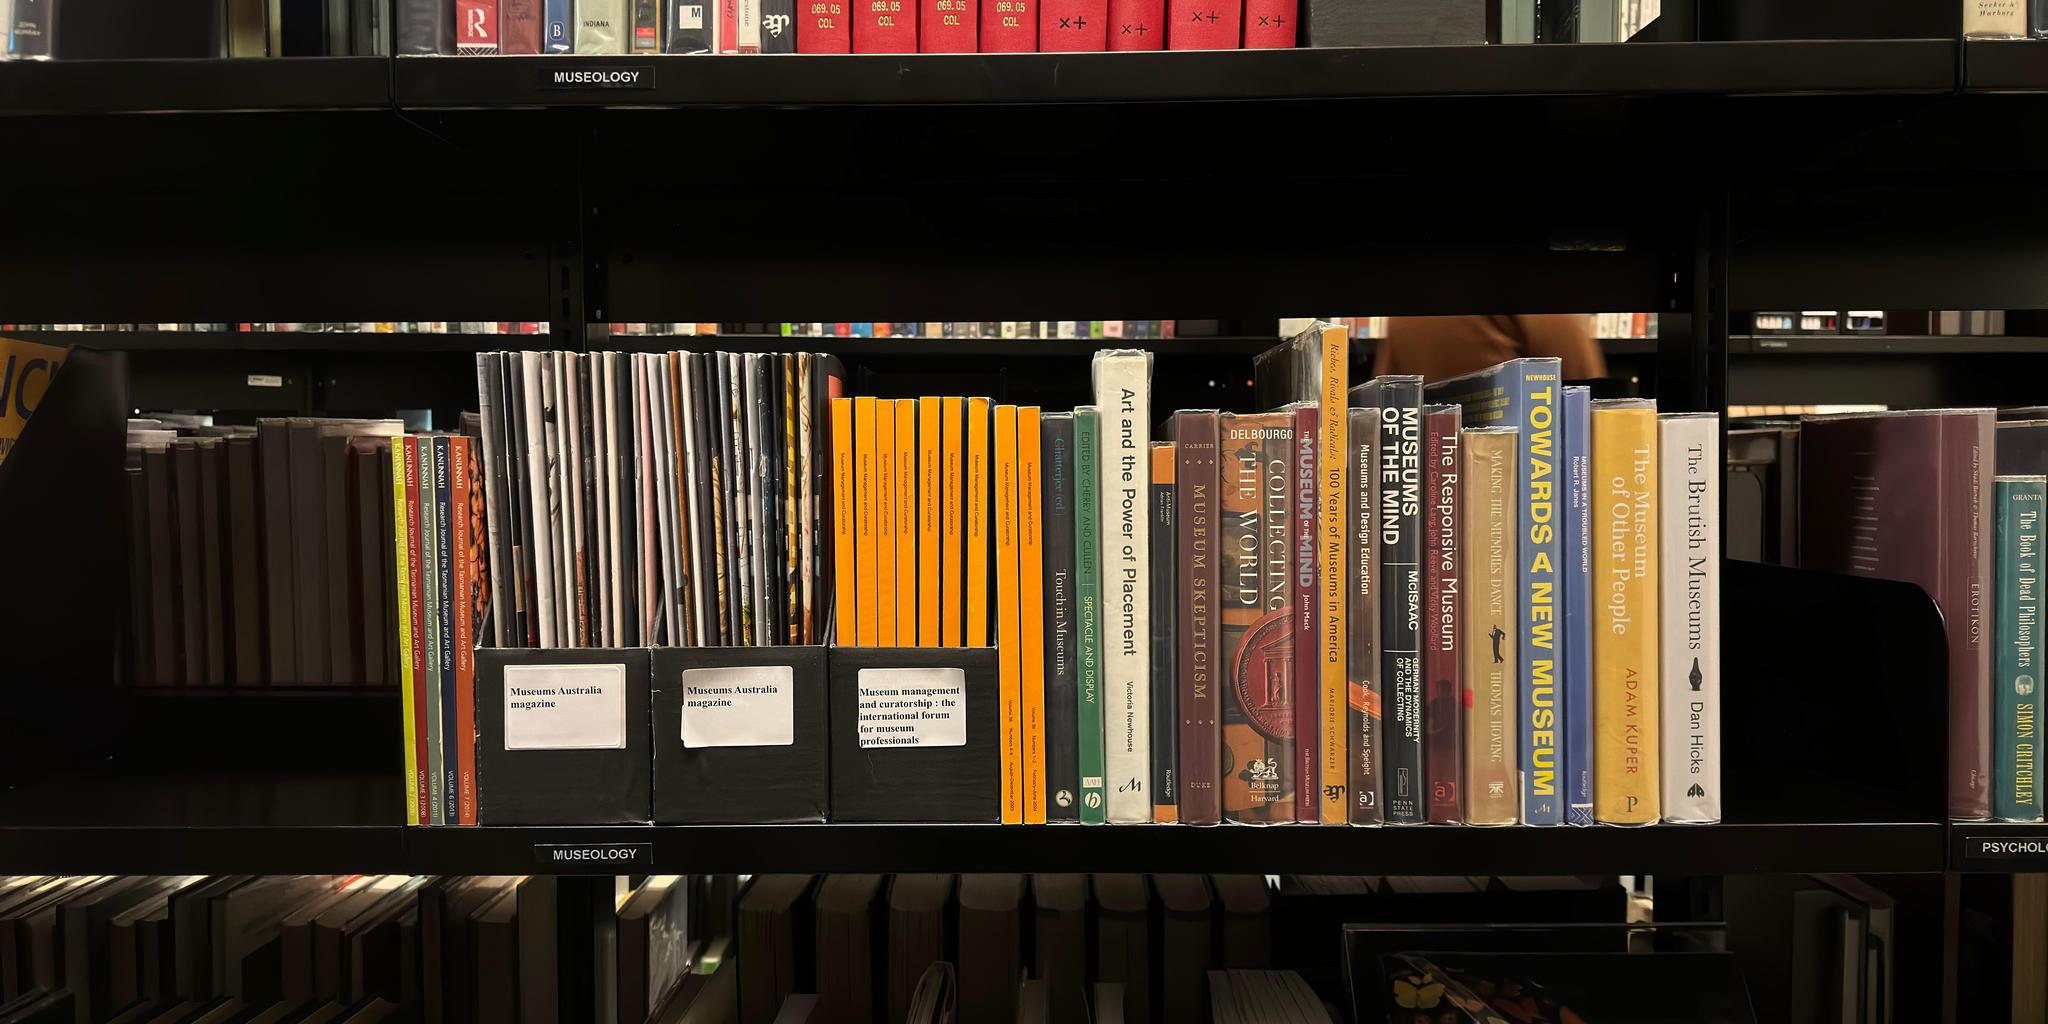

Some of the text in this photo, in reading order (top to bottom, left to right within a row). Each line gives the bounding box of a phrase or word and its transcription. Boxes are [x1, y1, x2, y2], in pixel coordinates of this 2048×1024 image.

[553, 24, 561, 37] B
[583, 20, 610, 28] INDIANA
[691, 8, 701, 18] M
[818, 18, 834, 29] COL
[878, 16, 894, 27] COL
[943, 15, 960, 26] COL
[1003, 17, 1019, 27] COL
[554, 71, 640, 83] MUSEOLOGY
[1329, 376, 1340, 402] Rivals
[1081, 431, 1090, 463] EDITED
[1230, 429, 1293, 440] DELBOURGO
[1329, 419, 1340, 460] Radicals:
[405, 444, 414, 487] KANUNNAH
[421, 446, 429, 489] KANUNNAH
[436, 445, 445, 488] KANUNNAH
[455, 445, 463, 489] KANUNNAH
[1081, 465, 1090, 476] BY
[1299, 438, 1313, 519] MUSEUM
[1329, 467, 1341, 488] 100
[1382, 407, 1400, 545] OF THE MIND
[1402, 406, 1419, 516] MUSEUMS
[1082, 479, 1091, 512] CHERRY
[1329, 492, 1341, 523] Years
[1634, 444, 1650, 578] The Museum
[2012, 493, 2042, 501] GRANTA
[1083, 517, 1092, 538] AND
[1121, 388, 1137, 656] Art and the Power of Placement
[1239, 452, 1258, 605] THE WORLD
[1269, 459, 1286, 611] COLLECTING
[1329, 526, 1341, 538] of
[1358, 444, 1371, 595] Museums and Design Education
[1490, 449, 1503, 616] MAKING THE MUMMIES DANCE
[1299, 535, 1313, 587] MIND
[1437, 431, 1458, 650] The Responsive Museum
[1608, 476, 1632, 635] of Other People
[1688, 444, 1707, 650] The Brutish Museums
[1329, 542, 1341, 598] Museums
[2014, 511, 2037, 667] The Book of Dead Philosophers
[1193, 484, 1206, 698] MUSEUM SKEPTICISM
[1302, 594, 1310, 610] John
[1329, 601, 1341, 612] in
[1408, 570, 1419, 631] McISAAC
[1530, 386, 1554, 796] TOWARDS A NEW MUSEUM
[1055, 568, 1068, 676] Touch in Museums
[1970, 583, 1980, 643] EROTIKON
[1084, 596, 1095, 704] SPECTACLE AND DISPLAY
[1329, 615, 1341, 663] America
[1396, 658, 1404, 669] OF
[510, 685, 602, 697] Museums Australia
[510, 699, 556, 710] magazine
[687, 684, 778, 696] Museums Australia
[687, 698, 732, 709] magazine
[859, 687, 960, 697] Museum management
[859, 701, 877, 709] and
[879, 699, 933, 709] curatorship
[941, 699, 956, 707] the
[859, 711, 950, 721] international forum
[859, 725, 874, 733] for
[1126, 681, 1135, 752] Victoria Newhouse
[1360, 680, 1371, 775] Cook, Reynolds and Speight
[1412, 694, 1420, 743] MODERNITY
[1490, 672, 1502, 762] THOMAS HOVING
[1626, 667, 1638, 774] ADAM KUPER
[859, 736, 919, 747] professionals
[1690, 701, 1704, 774] Dan Hicks
[2016, 703, 2034, 805] SIMON CRITCHLEY
[1250, 782, 1279, 790] Belknap
[553, 848, 637, 860] MUSEOLOGY
[1982, 842, 2048, 853] PSYCHOL
